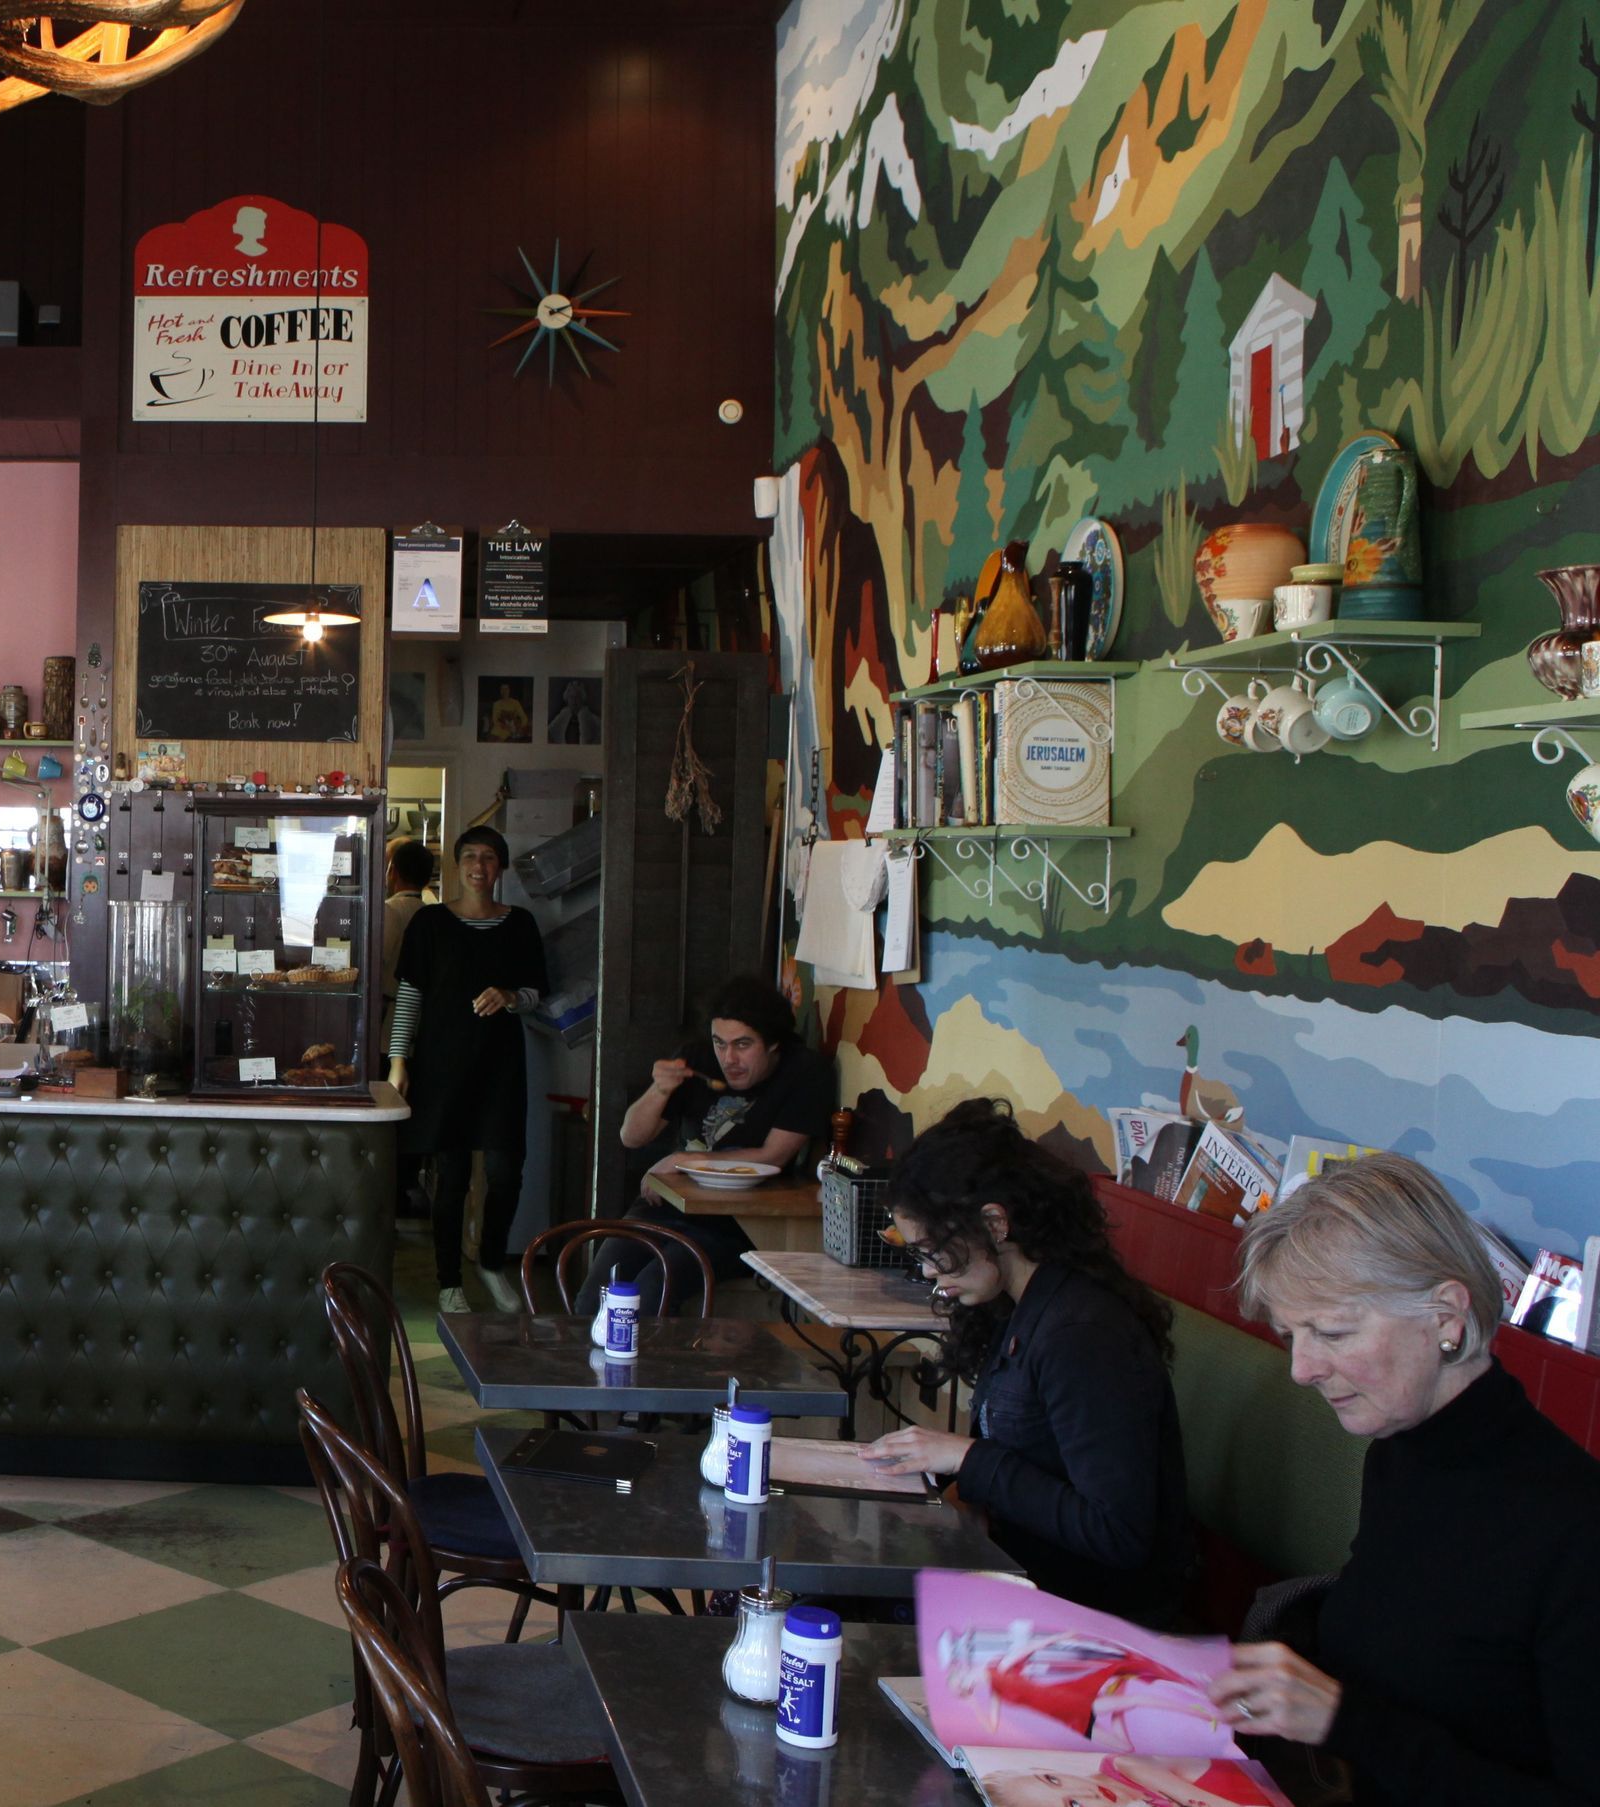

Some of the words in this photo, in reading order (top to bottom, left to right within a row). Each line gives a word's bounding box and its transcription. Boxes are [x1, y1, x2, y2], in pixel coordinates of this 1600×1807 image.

[144, 263, 359, 288] Refreshments
[148, 313, 184, 332] Hot
[187, 314, 215, 326] and
[220, 308, 354, 349] COFFEE
[156, 327, 208, 346] Fresh
[231, 359, 282, 376] Dine
[291, 359, 314, 376] In
[323, 361, 350, 376] or
[233, 381, 344, 403] TakeAway
[488, 541, 512, 552] THE
[515, 541, 542, 552] LAW
[412, 577, 440, 608] A
[172, 602, 235, 637] Winter
[200, 644, 238, 662] 30th
[246, 647, 309, 678] August
[228, 710, 260, 729] Book
[1026, 745, 1086, 763] JERUSALEM
[1130, 1119, 1146, 1148] viva
[1204, 1136, 1261, 1198] INTERIO
[793, 1676, 815, 1688] SALT
